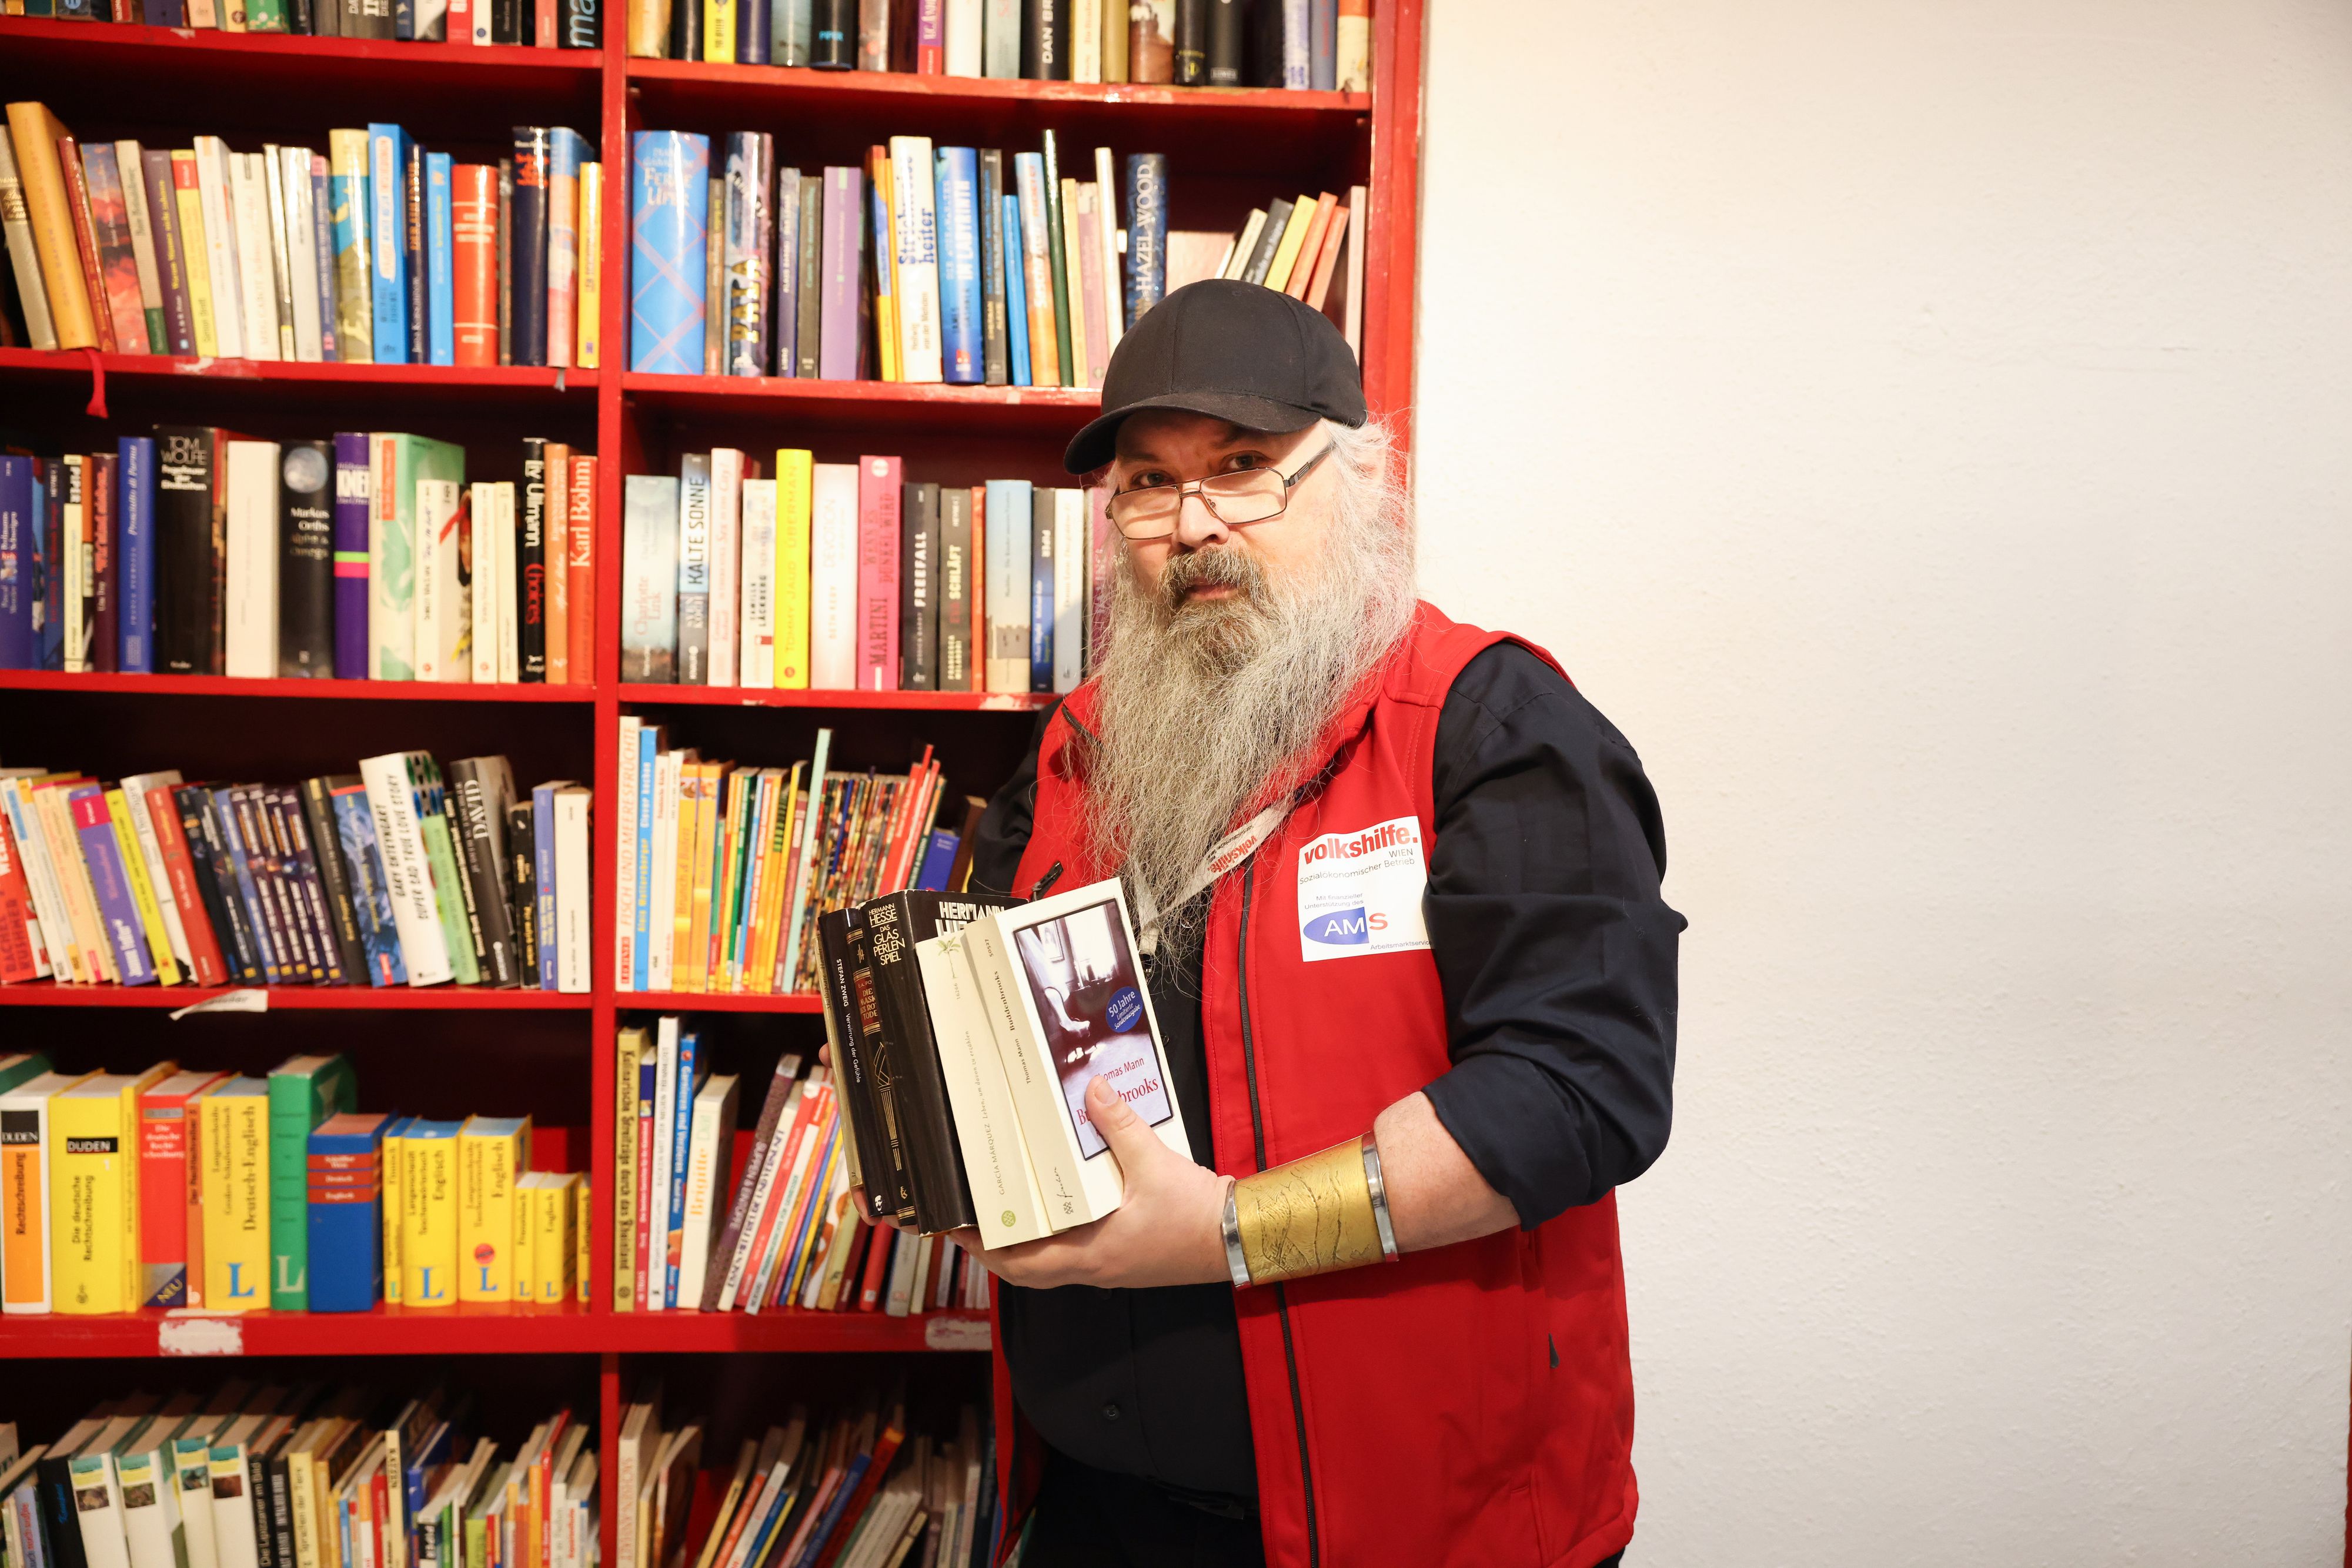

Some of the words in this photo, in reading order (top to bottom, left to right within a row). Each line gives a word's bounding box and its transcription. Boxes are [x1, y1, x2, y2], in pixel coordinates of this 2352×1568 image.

[820, 31, 844, 42] PIPER
[1043, 31, 1054, 64] DAN
[897, 155, 916, 265] Strichweise
[1136, 164, 1153, 228] WOOD
[918, 208, 935, 265] heiter
[1136, 233, 1152, 292] HAZEL
[160, 449, 208, 466] WOLFE
[169, 436, 200, 452] TOM
[568, 461, 592, 523] Böhm
[687, 477, 706, 530] SONNE
[523, 482, 546, 548] Ullmann
[784, 464, 799, 549] ÜBERMAN
[878, 492, 894, 529] WIRD
[714, 523, 729, 543] Sex
[822, 499, 837, 569] DEVOTION
[863, 528, 877, 565] WENN
[569, 527, 590, 569] Karl
[687, 536, 706, 584] KALTE
[878, 532, 895, 584] DUNKEL
[786, 560, 797, 599] JAUD
[914, 531, 927, 609] FREEFALL
[946, 544, 963, 600] SCHLÄFT
[525, 563, 546, 626] Choices
[634, 576, 649, 636] Charlotte
[647, 591, 663, 621] Link
[785, 604, 796, 653] TOMMY
[868, 597, 888, 666] MARTINI
[385, 774, 403, 805] STORY
[619, 724, 637, 845] MEERESFRÜCHTE
[396, 807, 410, 834] LOVE
[463, 777, 489, 837] DAVID
[374, 803, 400, 867] SHTEYNGART
[402, 836, 417, 862] TRUE
[1304, 823, 1418, 865] volkshilfe.
[622, 849, 636, 882] UND
[1388, 847, 1414, 858] WIEN
[393, 869, 406, 897] GARY
[409, 865, 423, 885] SAD
[1299, 862, 1382, 885] Sozialökonomischer
[1384, 857, 1415, 868] Betrieb
[413, 888, 430, 921] SUPER
[622, 885, 636, 926] FISCH
[677, 874, 689, 915] Brunch
[868, 902, 895, 915] HERMANN
[1304, 900, 1351, 910] Unterstützung
[1327, 892, 1363, 901] finanzieller
[870, 908, 897, 926] HESSE
[880, 924, 890, 932] DAS
[1323, 912, 1389, 938] AMS
[873, 938, 906, 958] PERLEN
[874, 929, 900, 945] GLAS
[984, 938, 994, 958] 50527
[620, 937, 630, 985] LECHNER
[836, 958, 846, 985] STEFAN
[880, 951, 902, 966] SPIEL
[840, 985, 854, 1007] ZWEIG
[863, 988, 873, 997] DIE
[994, 969, 1016, 1031] Buddenbrooks
[1108, 1005, 1119, 1018] 50
[1117, 991, 1136, 1013] Jahre
[863, 1009, 878, 1021] TODE
[1114, 1004, 1141, 1030] Sonderausgabe
[1116, 1003, 1134, 1020] Limitierte
[845, 1013, 858, 1047] Verwirrung
[853, 1059, 867, 1084] Gefühle
[964, 1029, 975, 1055] erzählen
[1014, 1038, 1024, 1057] Mann
[972, 1065, 981, 1084] davon
[1020, 1058, 1032, 1084] Thomas
[1124, 1057, 1145, 1072] Mann
[620, 1049, 636, 1112] Kulinarische
[679, 1065, 692, 1111] Garnieren
[977, 1085, 984, 1095] um
[676, 1112, 689, 1129] und
[980, 1096, 988, 1118] Leben,
[1, 1131, 39, 1142] DUDEN
[146, 1132, 182, 1142] deutsche
[155, 1124, 171, 1133] Die
[619, 1115, 636, 1167] Streifzüge
[983, 1121, 998, 1161] MÁRQUEZ
[67, 1139, 111, 1153] DUDEN
[103, 1159, 111, 1172] 1
[993, 1163, 1006, 1193] GARCÍA
[620, 1168, 634, 1195] durch
[688, 1148, 709, 1216] Brigitte
[620, 1199, 634, 1218] das
[72, 1228, 82, 1245] Die
[619, 1219, 634, 1272] Rheinland
[227, 1263, 255, 1298] L
[276, 1255, 305, 1293] L
[418, 1266, 444, 1299] L
[479, 1265, 498, 1293] L
[157, 1278, 183, 1305] NEU
[519, 1281, 530, 1297] L
[546, 1281, 557, 1298] L
